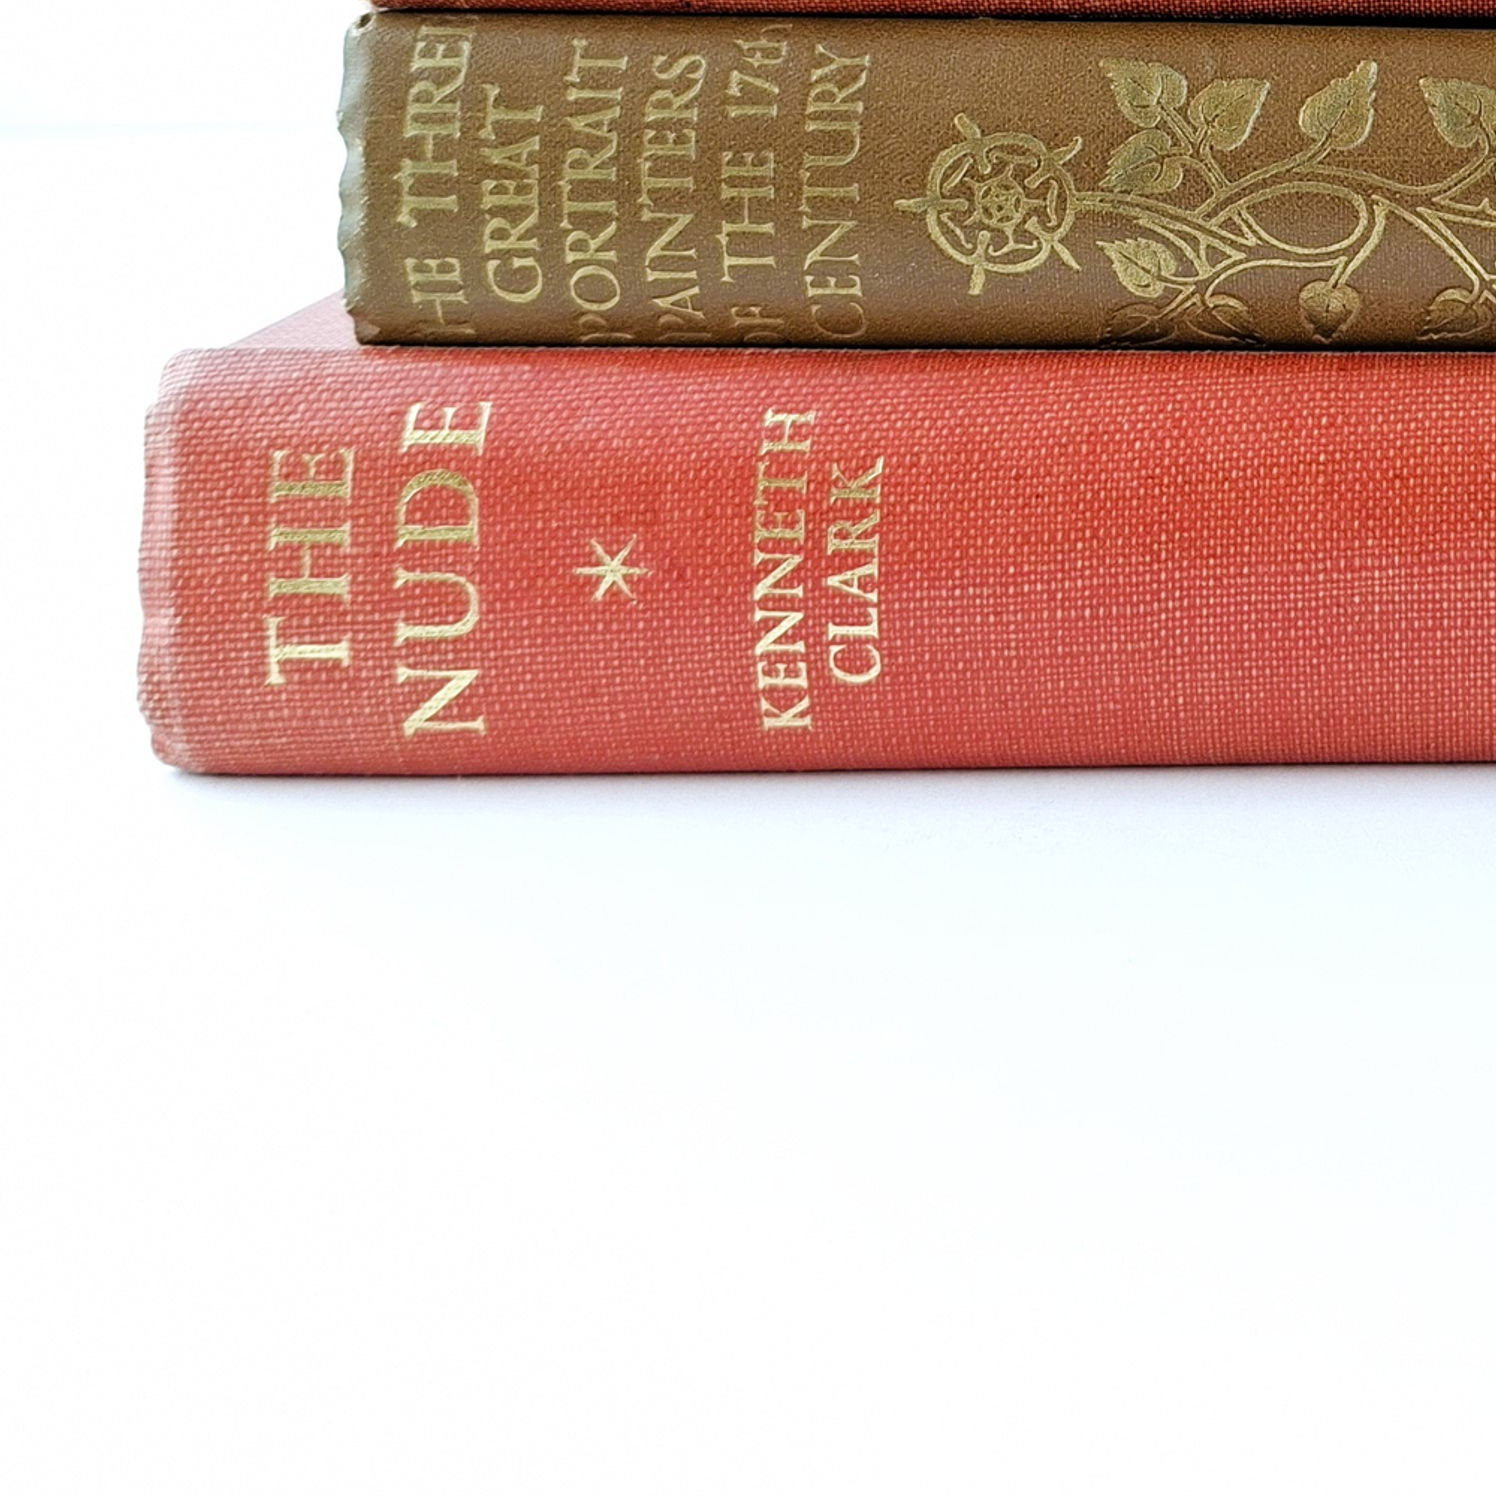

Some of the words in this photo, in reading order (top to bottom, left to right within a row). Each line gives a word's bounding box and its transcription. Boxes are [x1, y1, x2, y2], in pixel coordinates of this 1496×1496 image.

[404, 257, 476, 338] HE
[480, 83, 544, 304] GREAT
[560, 37, 633, 342] PORTRAIT
[638, 53, 708, 341] PAINTERS
[717, 150, 777, 284] THE
[799, 44, 872, 339] CENTURY
[264, 446, 354, 686] THE
[395, 401, 493, 739] NUDE
[753, 407, 816, 732] KENNETH
[828, 456, 886, 685] CLARK
